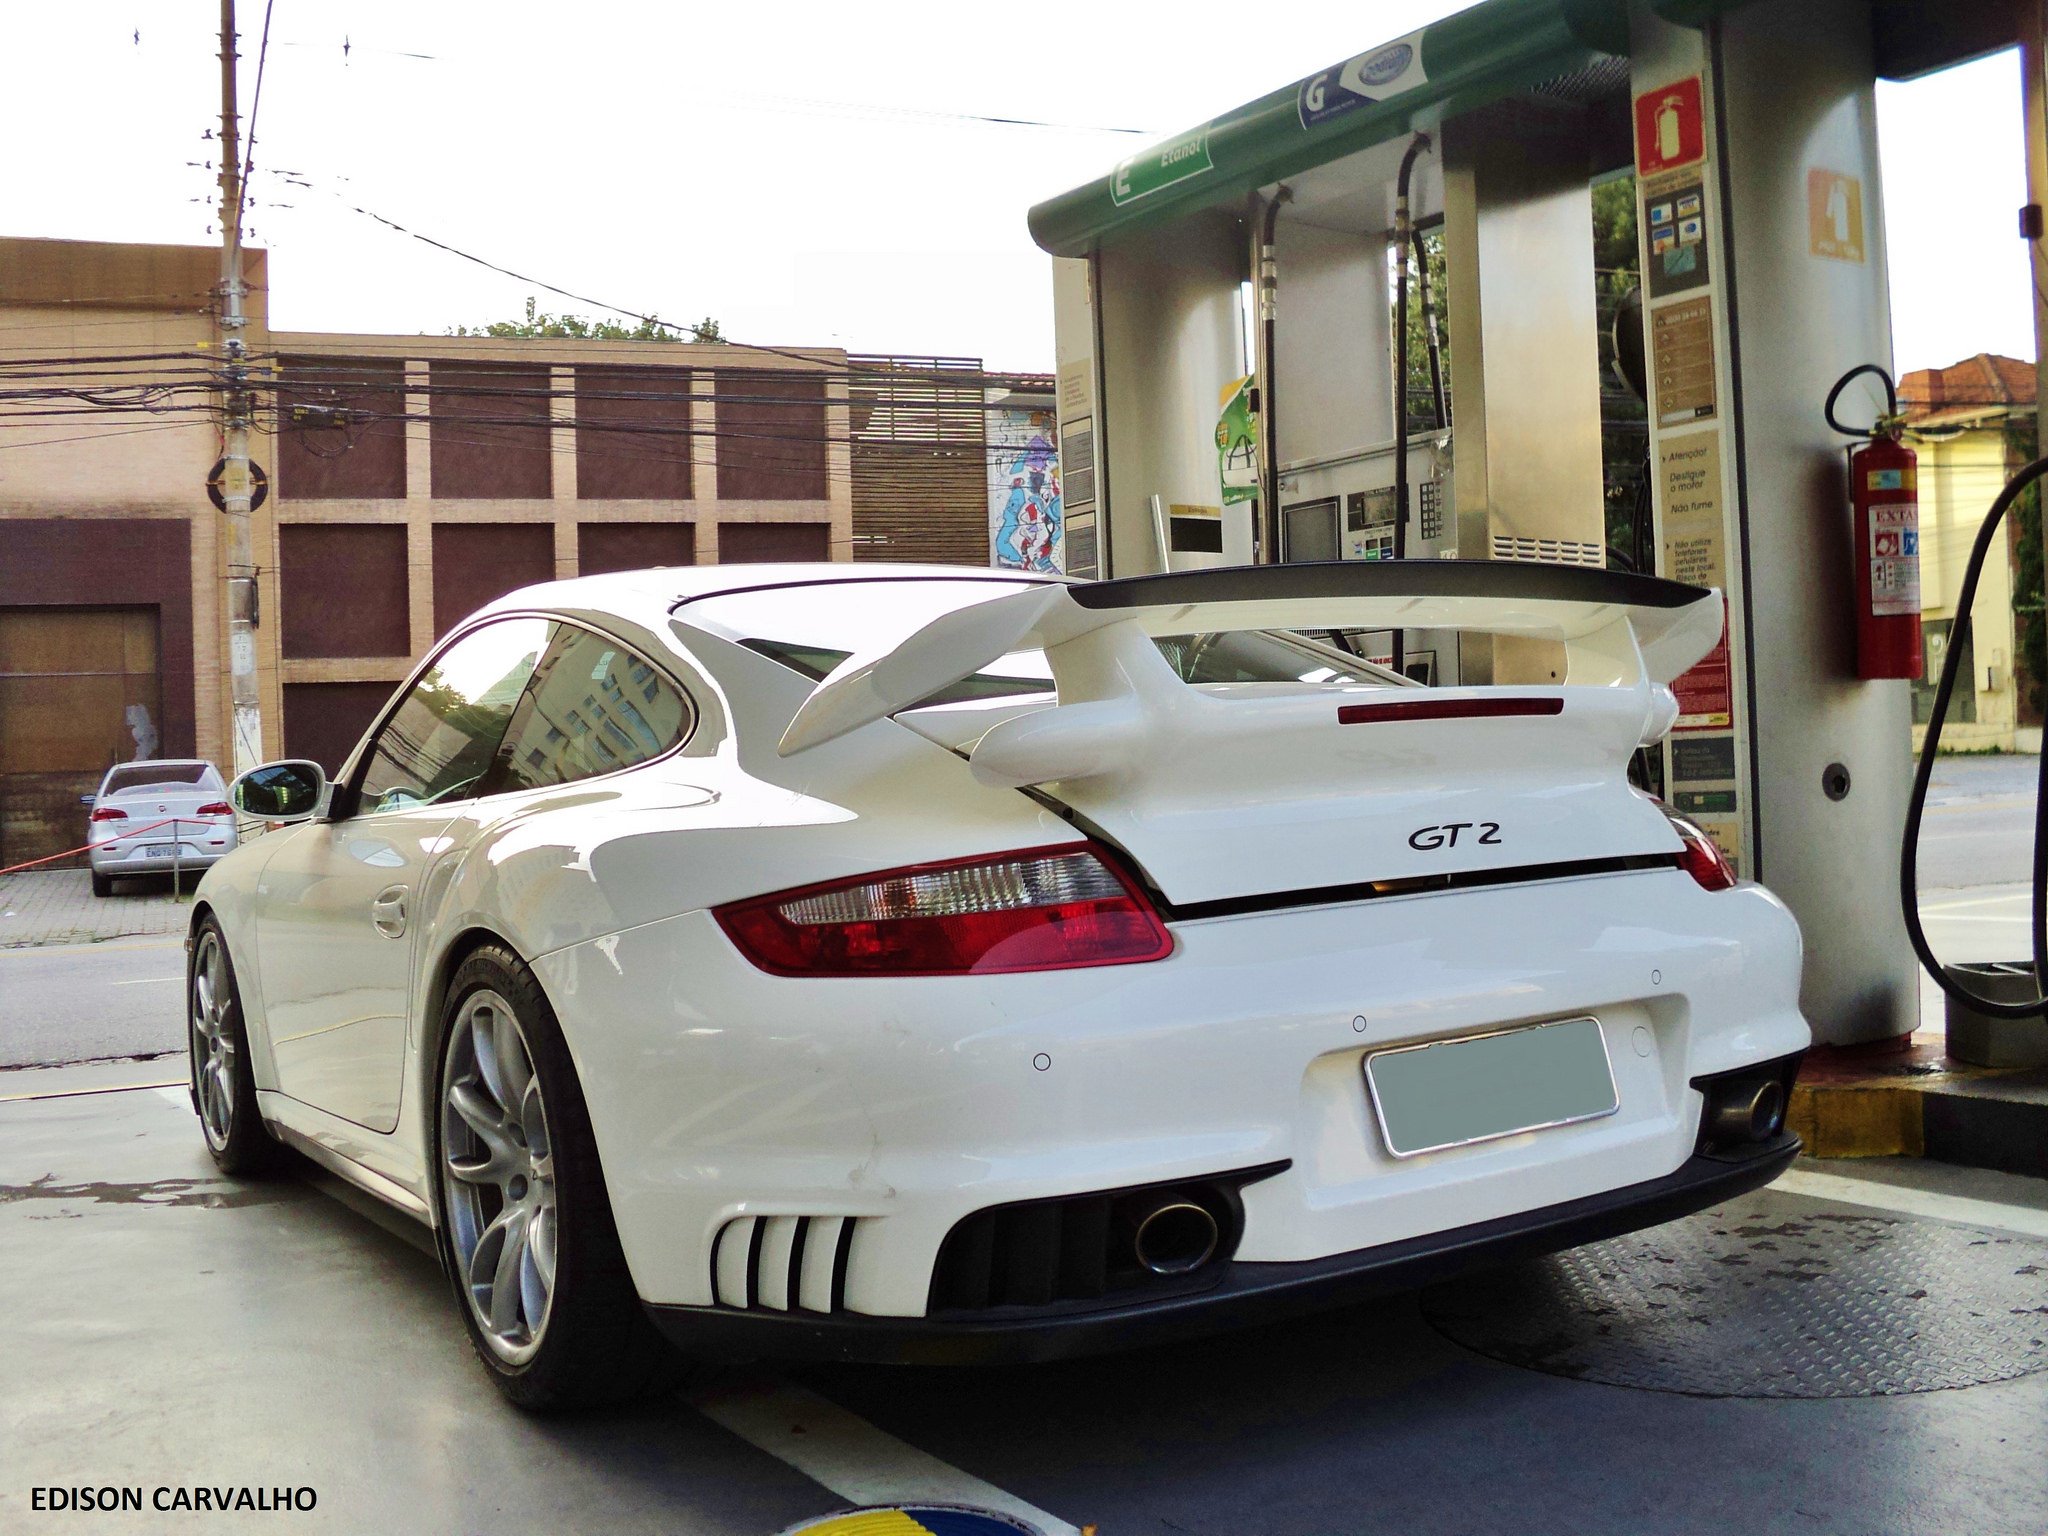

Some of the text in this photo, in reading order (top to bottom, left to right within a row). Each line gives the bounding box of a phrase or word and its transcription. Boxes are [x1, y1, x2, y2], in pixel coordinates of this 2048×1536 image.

[1305, 72, 1328, 112] G
[1160, 136, 1201, 168] Etanol
[1115, 156, 1136, 197] E
[1669, 470, 1706, 482] Desligue
[1678, 480, 1704, 491] motor
[1671, 501, 1713, 514] Não fume
